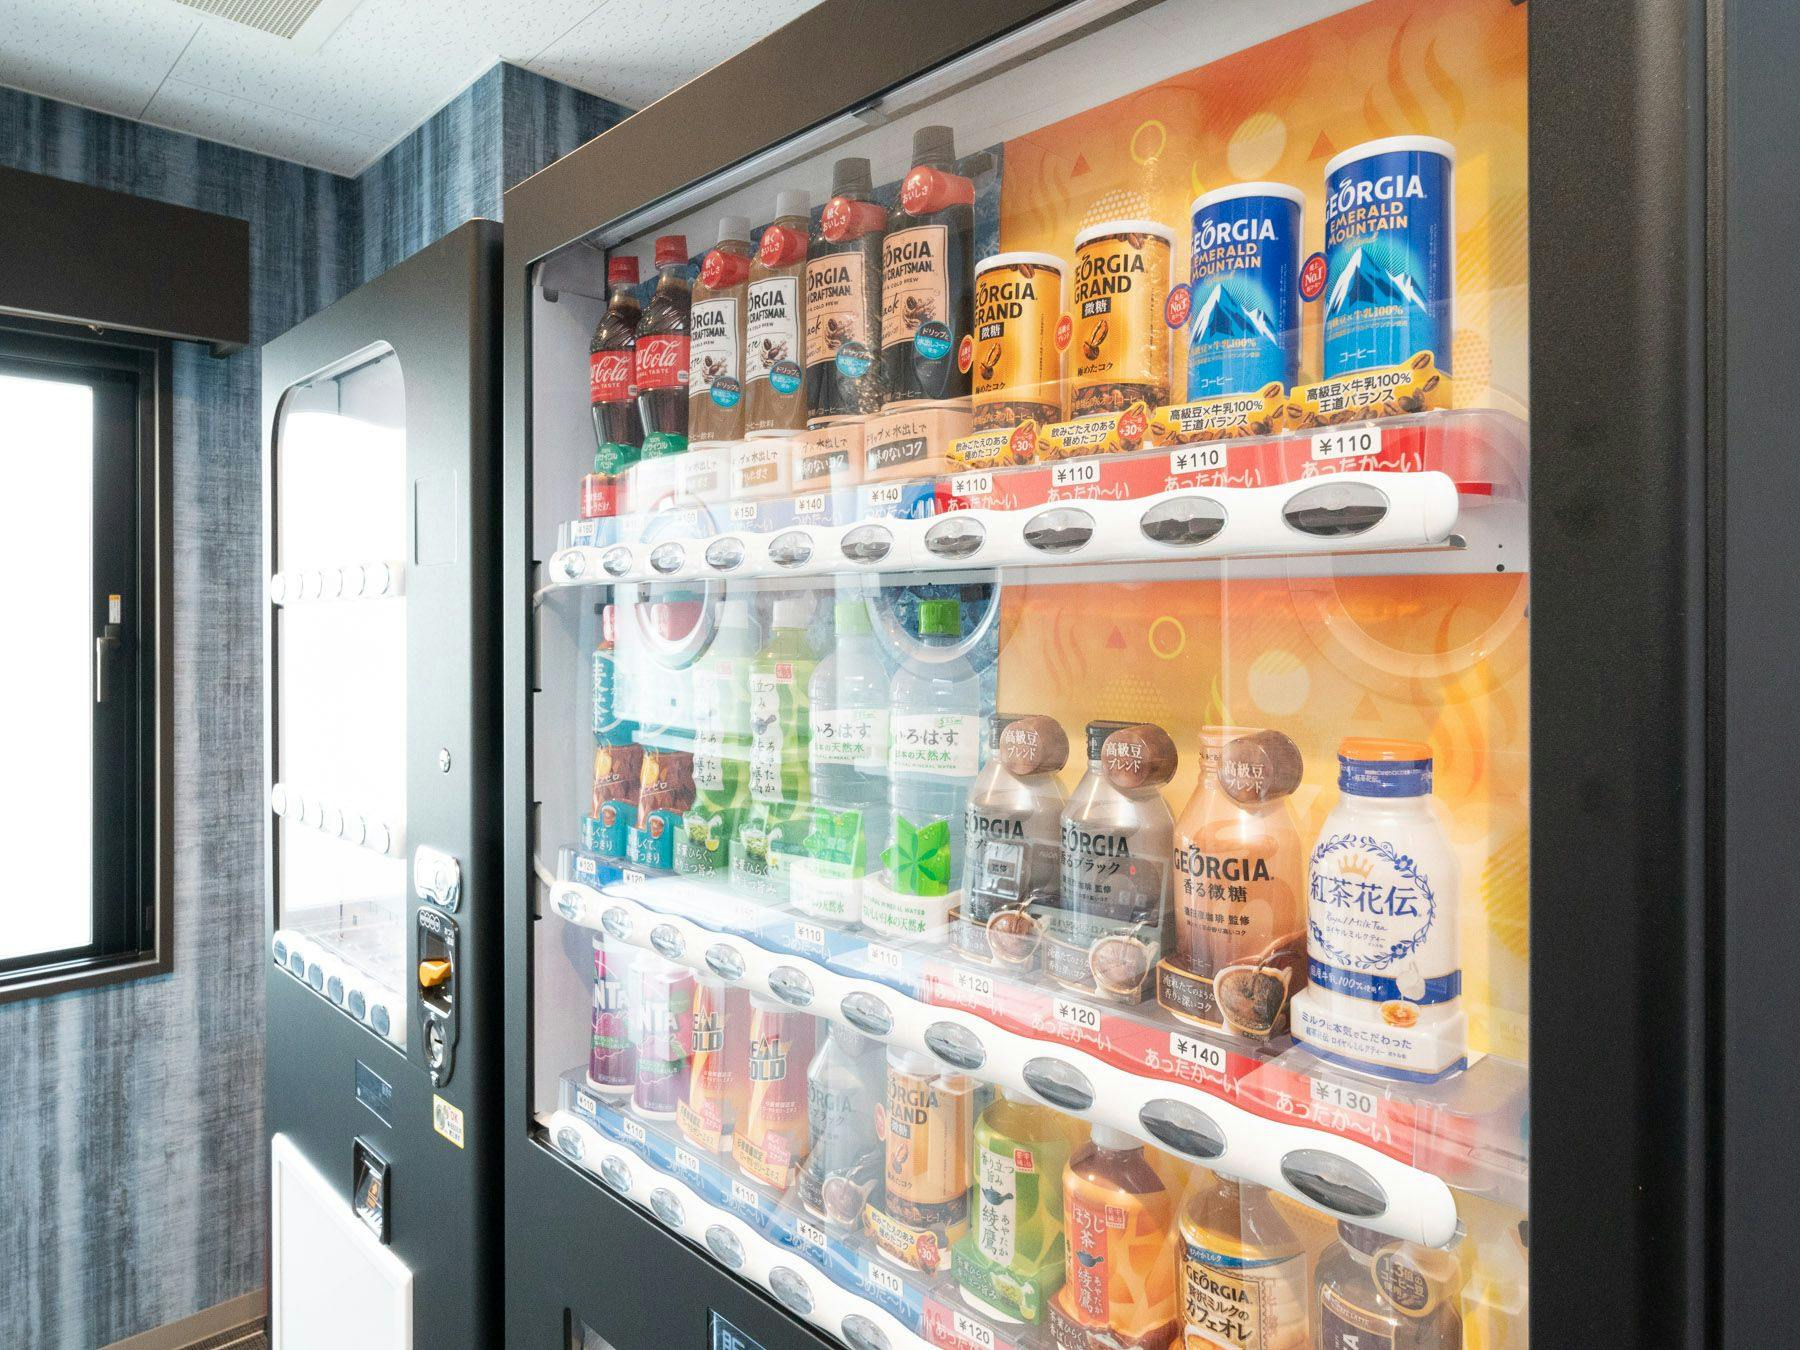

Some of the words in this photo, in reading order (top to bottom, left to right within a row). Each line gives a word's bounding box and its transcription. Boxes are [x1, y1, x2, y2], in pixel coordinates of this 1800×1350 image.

[1330, 202, 1405, 233] EMERALD
[1327, 216, 1408, 246] MOUNTAIN
[884, 241, 932, 268] ORGIA
[1194, 243, 1258, 267] EMERALD
[887, 261, 932, 280] CRAFTSMAN
[1075, 253, 1145, 284] EORGIA
[1191, 257, 1261, 279] MOUNTAIN
[1305, 268, 1322, 284] No.1
[808, 266, 851, 291] ORGIA
[750, 290, 786, 310] ORGIA
[810, 286, 851, 304] CRAFTSMAN
[883, 293, 899, 316] ack
[976, 281, 1037, 308] EORGIA
[750, 308, 786, 324] CRAFTSMAN
[1084, 299, 1108, 317] 微糖
[691, 310, 727, 330] ORGIA
[807, 315, 822, 336] ack
[922, 328, 949, 341] ドリップと
[980, 325, 1001, 341] 微糖
[1340, 348, 1377, 364] コーヒー
[1201, 376, 1233, 388] コーヒー
[1319, 390, 1395, 413] 王道バランス
[1051, 421, 1116, 438] 飲みごたえのある
[1181, 415, 1248, 432] 王道バランス
[955, 436, 1008, 451] 飲みごたえのある
[1062, 433, 1107, 447] 極めたコク
[1319, 433, 1372, 456] ¥110
[872, 443, 922, 465] 味のないコク
[964, 448, 1000, 461] 極めたコク
[1177, 450, 1219, 469] ¥110
[1057, 466, 1094, 482] ¥110
[871, 488, 899, 501] ¥140
[956, 478, 988, 493] ¥110
[799, 498, 822, 510] ¥140
[1005, 730, 1038, 746] 高級豆
[1007, 746, 1036, 761] ブレンド
[1106, 742, 1142, 759] 高級豆
[1108, 759, 1141, 773] ブレンド
[1224, 760, 1265, 779] 高級豆
[1227, 778, 1263, 795] ブレンド
[964, 811, 1024, 840] EORGIA
[1061, 826, 1130, 858] EORGIA
[1174, 845, 1270, 882] GEORGIA
[1183, 878, 1248, 904] 香る微糖
[1311, 871, 1418, 918] 紅茶花伝
[1228, 914, 1250, 926] 監修
[797, 926, 821, 943] ¥110
[959, 973, 990, 995] ¥120
[693, 1007, 723, 1032] EAL
[1059, 1003, 1095, 1026] ¥120
[750, 1033, 786, 1058] EAL
[1177, 1038, 1220, 1066] ¥140
[750, 1058, 787, 1080] OLD
[889, 1077, 939, 1109] ORGIA
[1316, 1081, 1371, 1113] ¥130
[678, 1151, 697, 1171] ¥110
[735, 1186, 756, 1205] ¥110
[800, 1224, 824, 1246] ¥120
[872, 1268, 899, 1291] ¥110
[1186, 1264, 1250, 1303] GEORGIA
[1187, 1298, 1252, 1342] カフェオレ
[958, 1317, 990, 1344] ¥120
